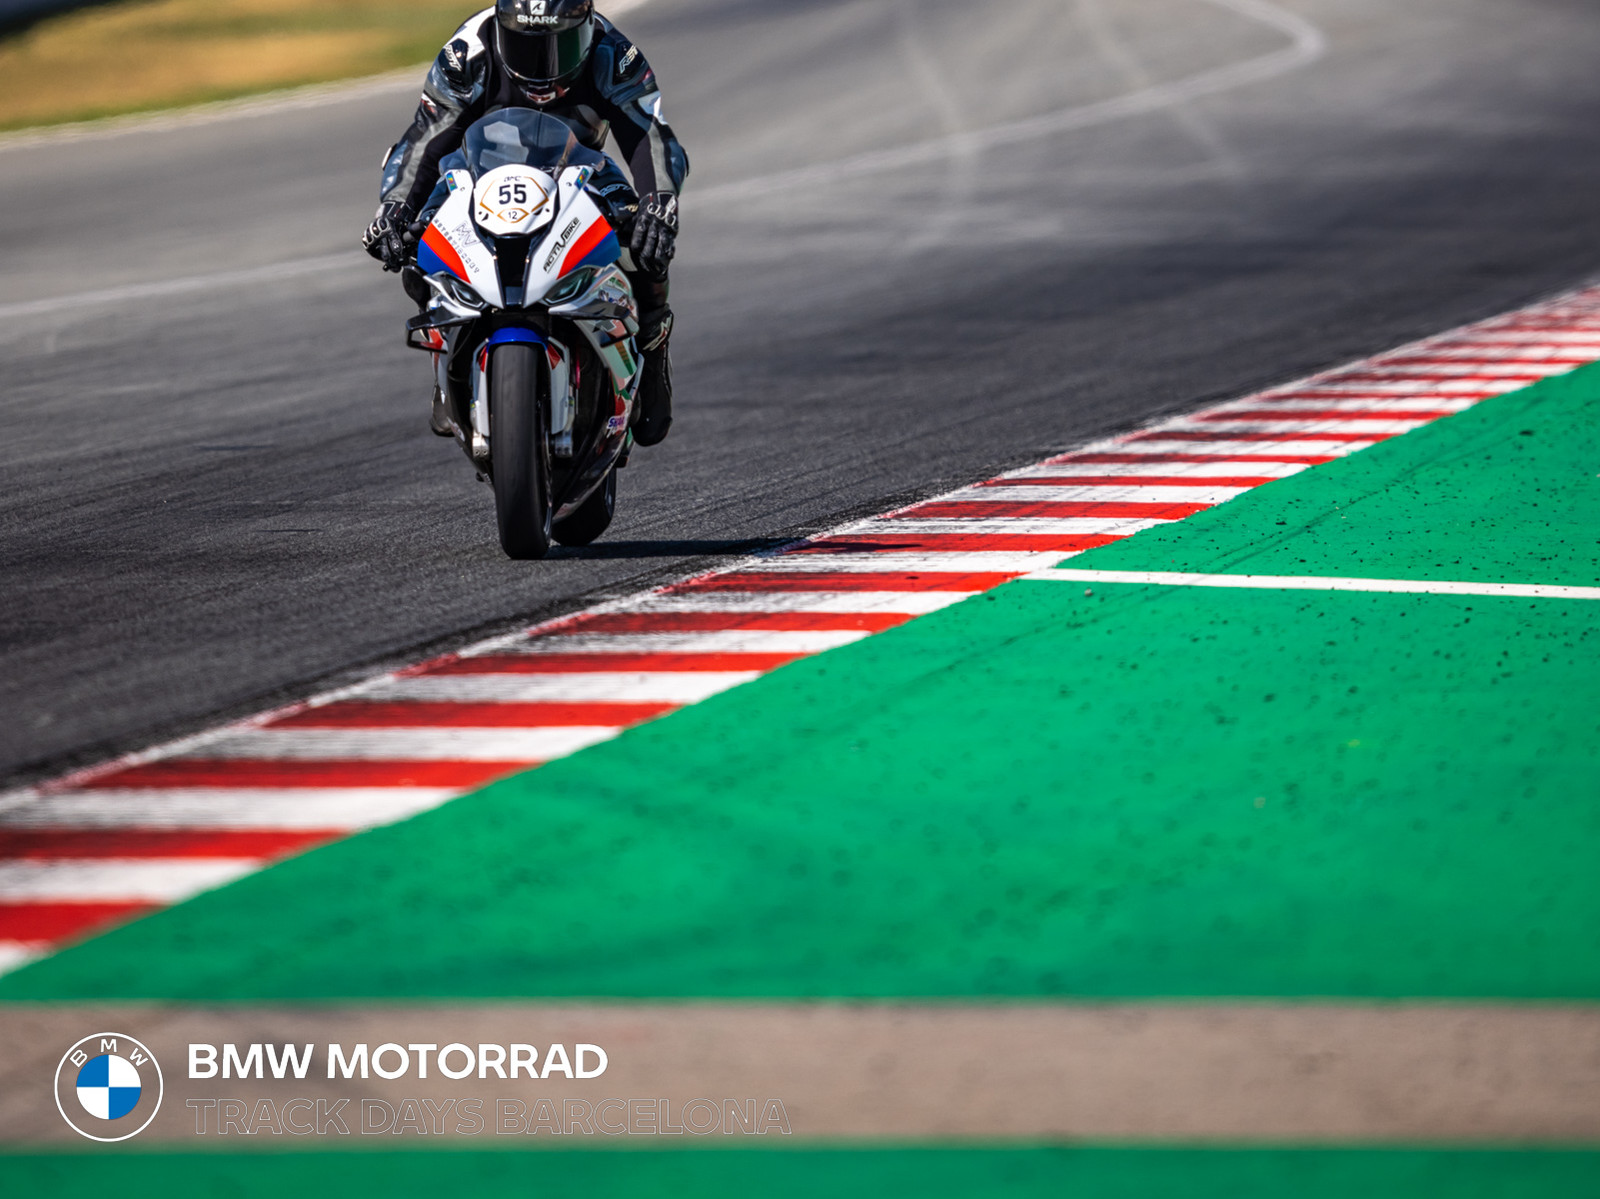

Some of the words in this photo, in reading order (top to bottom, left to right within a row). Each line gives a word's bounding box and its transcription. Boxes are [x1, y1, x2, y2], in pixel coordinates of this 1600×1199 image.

[517, 14, 558, 24] SHARK
[499, 184, 526, 204] 55
[508, 211, 517, 220] 12
